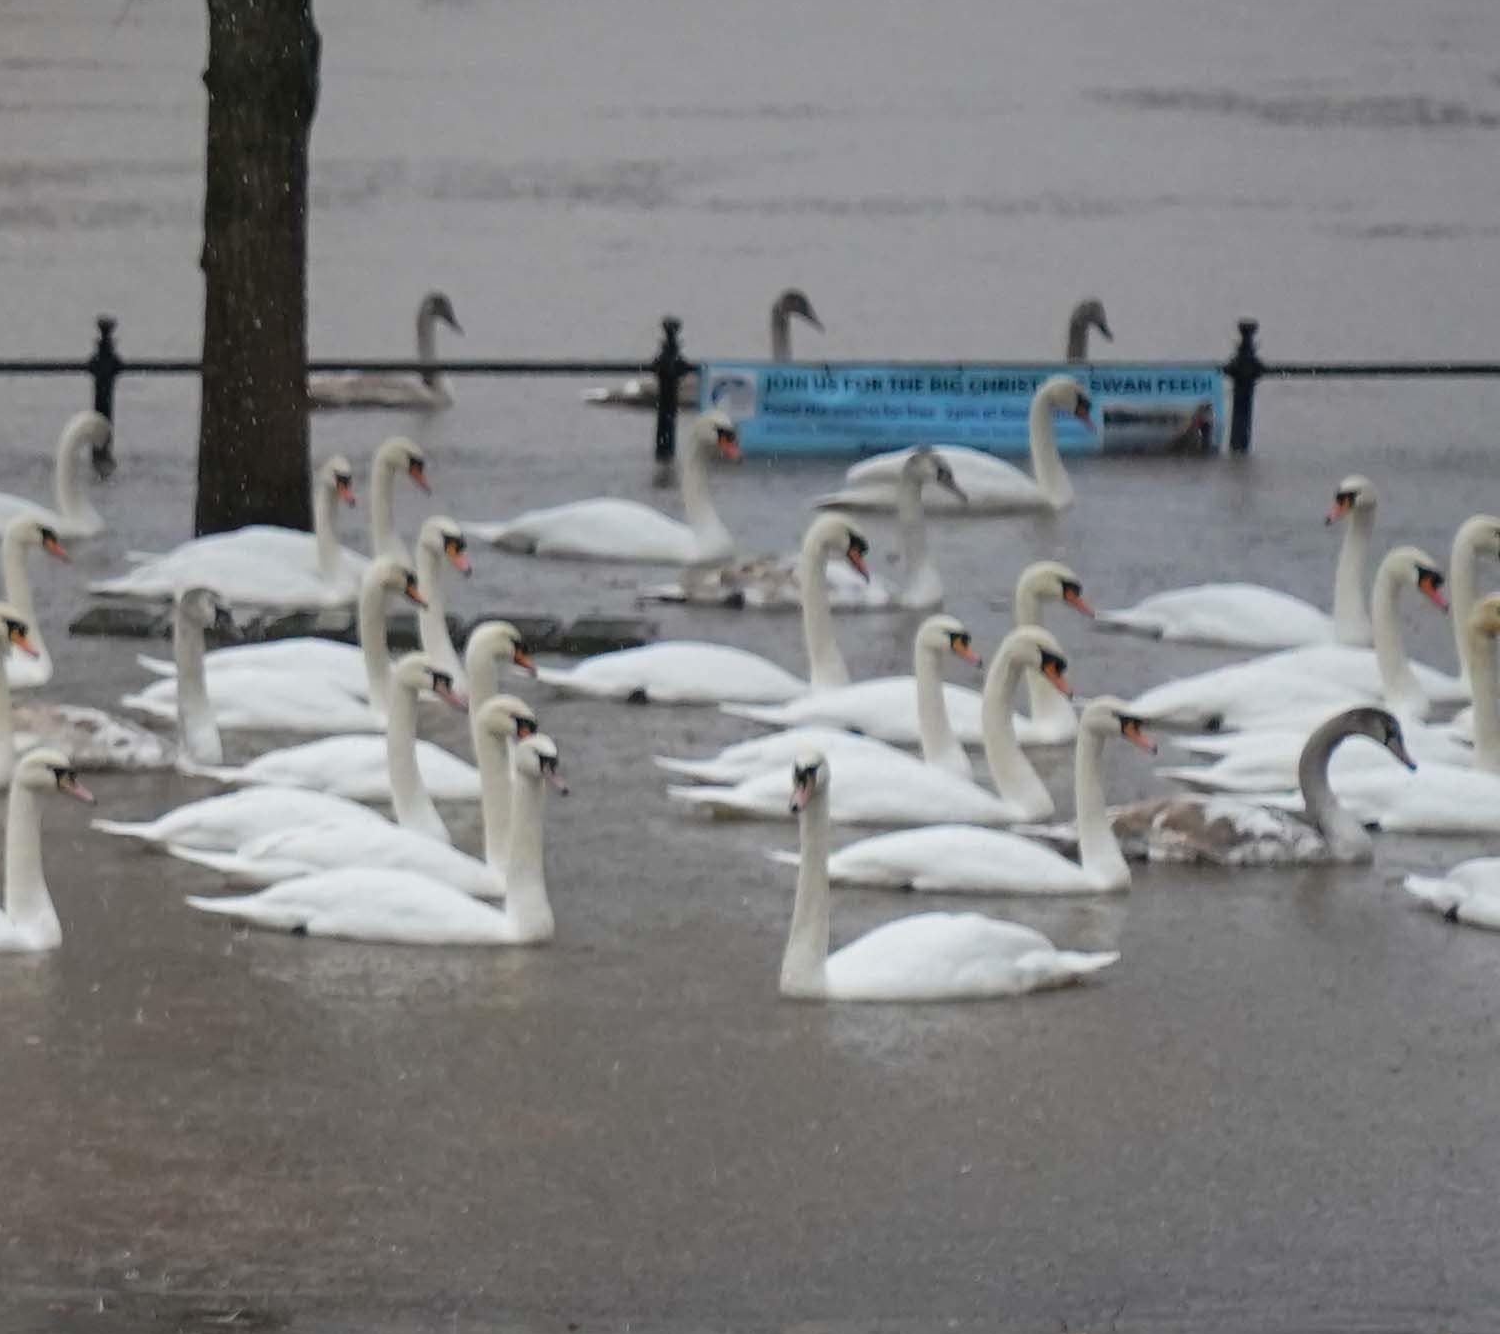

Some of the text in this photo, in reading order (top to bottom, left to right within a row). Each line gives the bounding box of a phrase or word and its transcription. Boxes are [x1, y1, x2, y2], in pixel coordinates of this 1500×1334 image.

[766, 374, 809, 393] JOIN
[814, 375, 838, 394] US
[843, 375, 884, 395] FOR
[889, 376, 924, 394] THE
[930, 376, 964, 395] BIG
[1090, 378, 1151, 394] SWAN
